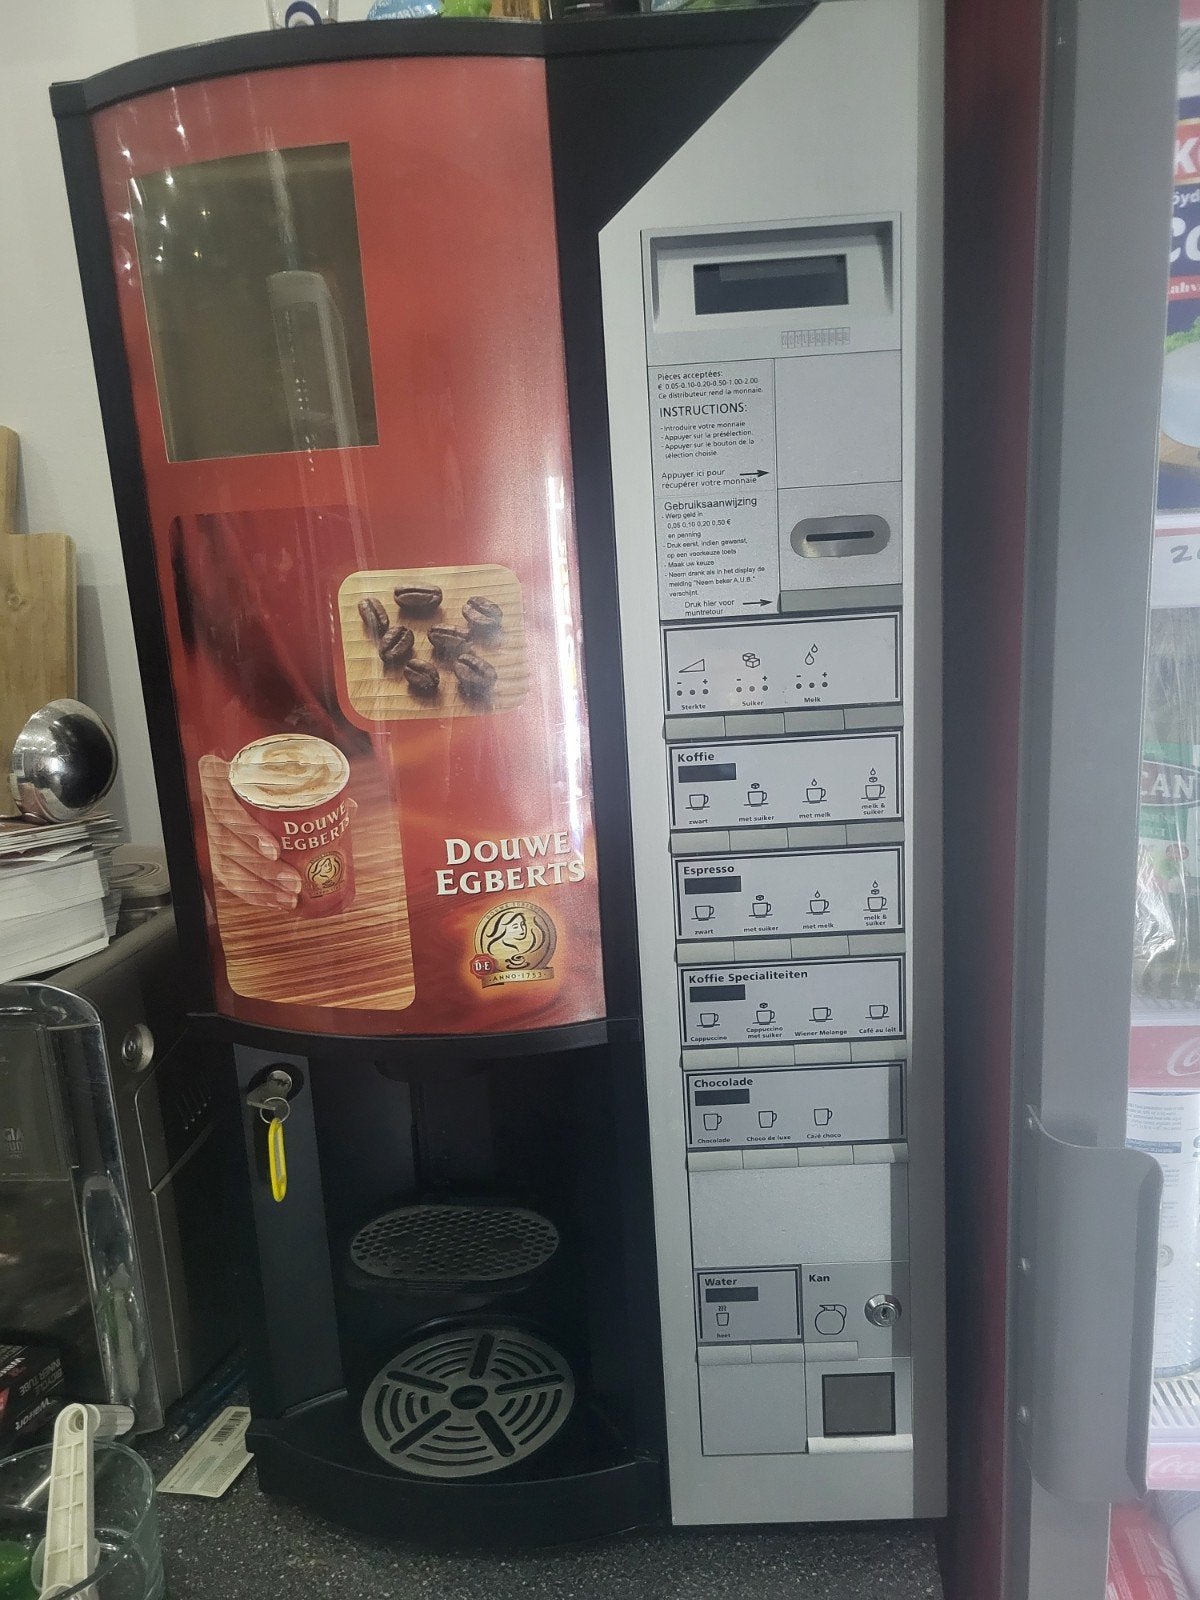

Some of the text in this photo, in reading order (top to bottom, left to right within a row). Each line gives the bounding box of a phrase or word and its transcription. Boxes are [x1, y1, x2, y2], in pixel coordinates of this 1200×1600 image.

[668, 391, 706, 399] distributeur
[660, 402, 748, 418] INSTRUCTIONS:
[664, 434, 692, 442] Appuyer
[665, 443, 692, 451] Appuyer
[661, 469, 726, 480] Appuyer ici pour
[661, 476, 758, 490] récupérer votre monnaie
[664, 497, 758, 511] Gebruiksaanwijzing
[665, 512, 682, 520] Werp
[677, 531, 702, 539] penning
[735, 566, 756, 575] display
[668, 580, 692, 588] melding
[716, 577, 733, 585] beker
[685, 601, 702, 609] Druk
[703, 599, 716, 607] hier
[685, 608, 723, 617] muntretour
[681, 703, 706, 711] Sterkte
[677, 751, 715, 763] Koffie
[283, 800, 345, 835] DOUWE
[812, 811, 831, 819] melk
[444, 831, 572, 866] DOUWE
[683, 865, 735, 876] Espresso
[435, 858, 586, 896] EGBERTS
[689, 970, 808, 985] Koffie Specialiteiten
[746, 1026, 784, 1034] Cappuccino
[819, 1028, 848, 1037] Melange
[690, 1035, 728, 1043] Cappuccino
[694, 1078, 754, 1088] Chocolade
[705, 1278, 738, 1287] Water
[809, 1274, 830, 1283] Kan
